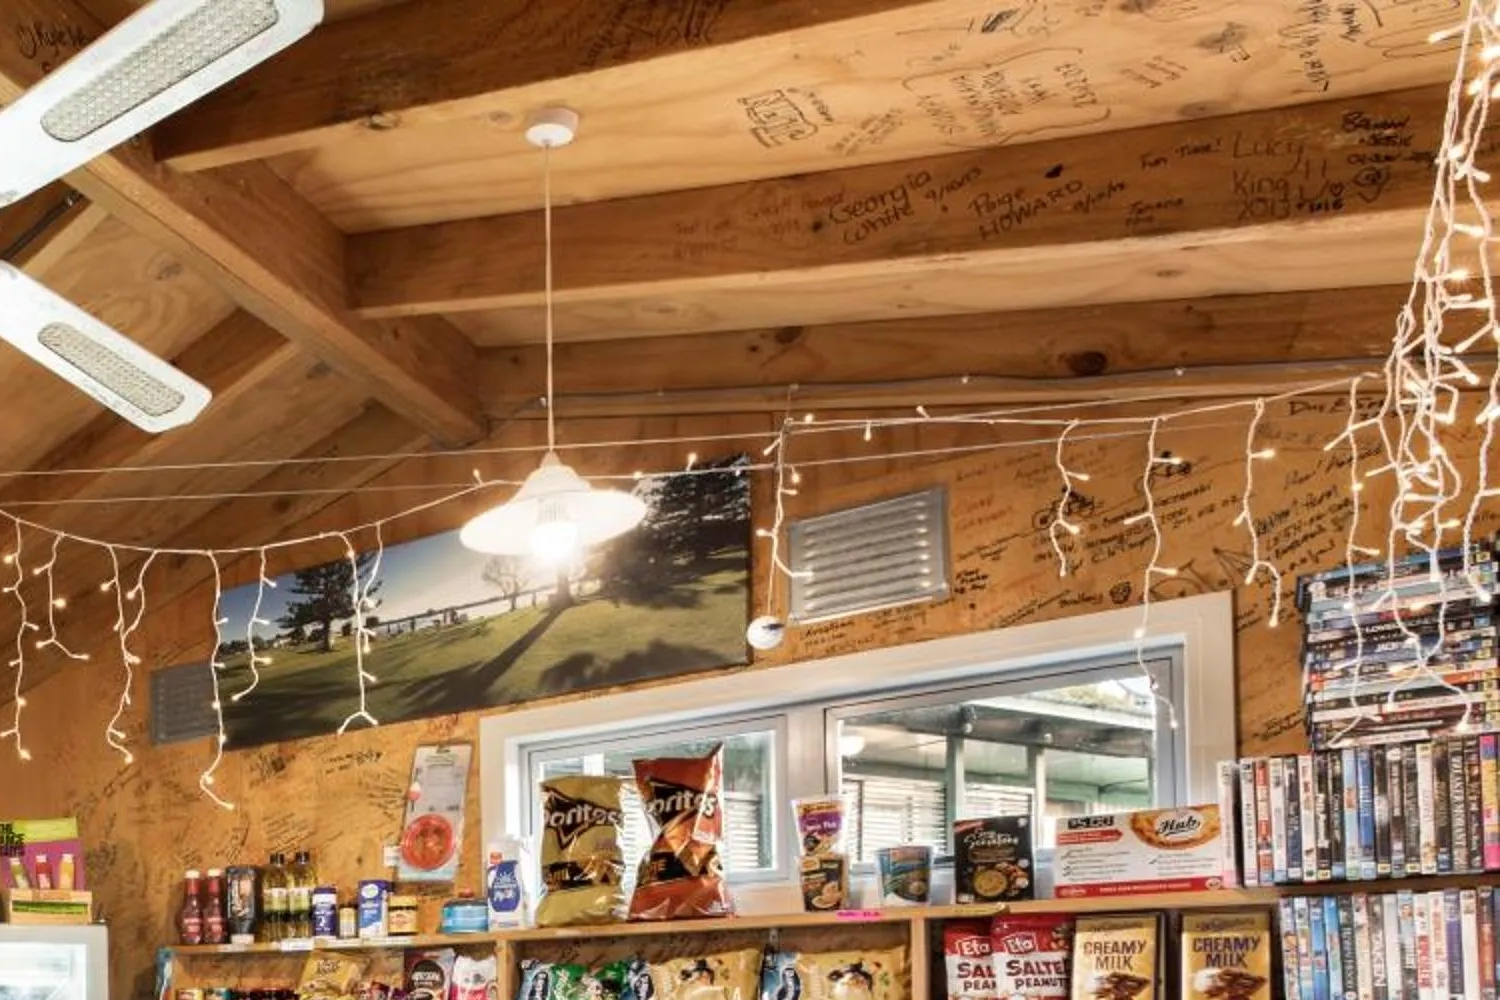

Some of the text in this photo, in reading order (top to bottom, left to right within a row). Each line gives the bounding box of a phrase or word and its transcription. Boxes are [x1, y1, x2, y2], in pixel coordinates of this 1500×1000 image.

[643, 790, 718, 818] oritos
[1157, 815, 1201, 836] Hub
[962, 939, 990, 955] Eta
[1005, 936, 1033, 953] Eta
[1083, 938, 1147, 957] CREAMY
[1192, 935, 1261, 953] CREAMY
[1094, 956, 1133, 971] MILK
[1205, 951, 1248, 969] MILK
[957, 962, 996, 979] SAL
[1014, 977, 1070, 990] PEANUT
